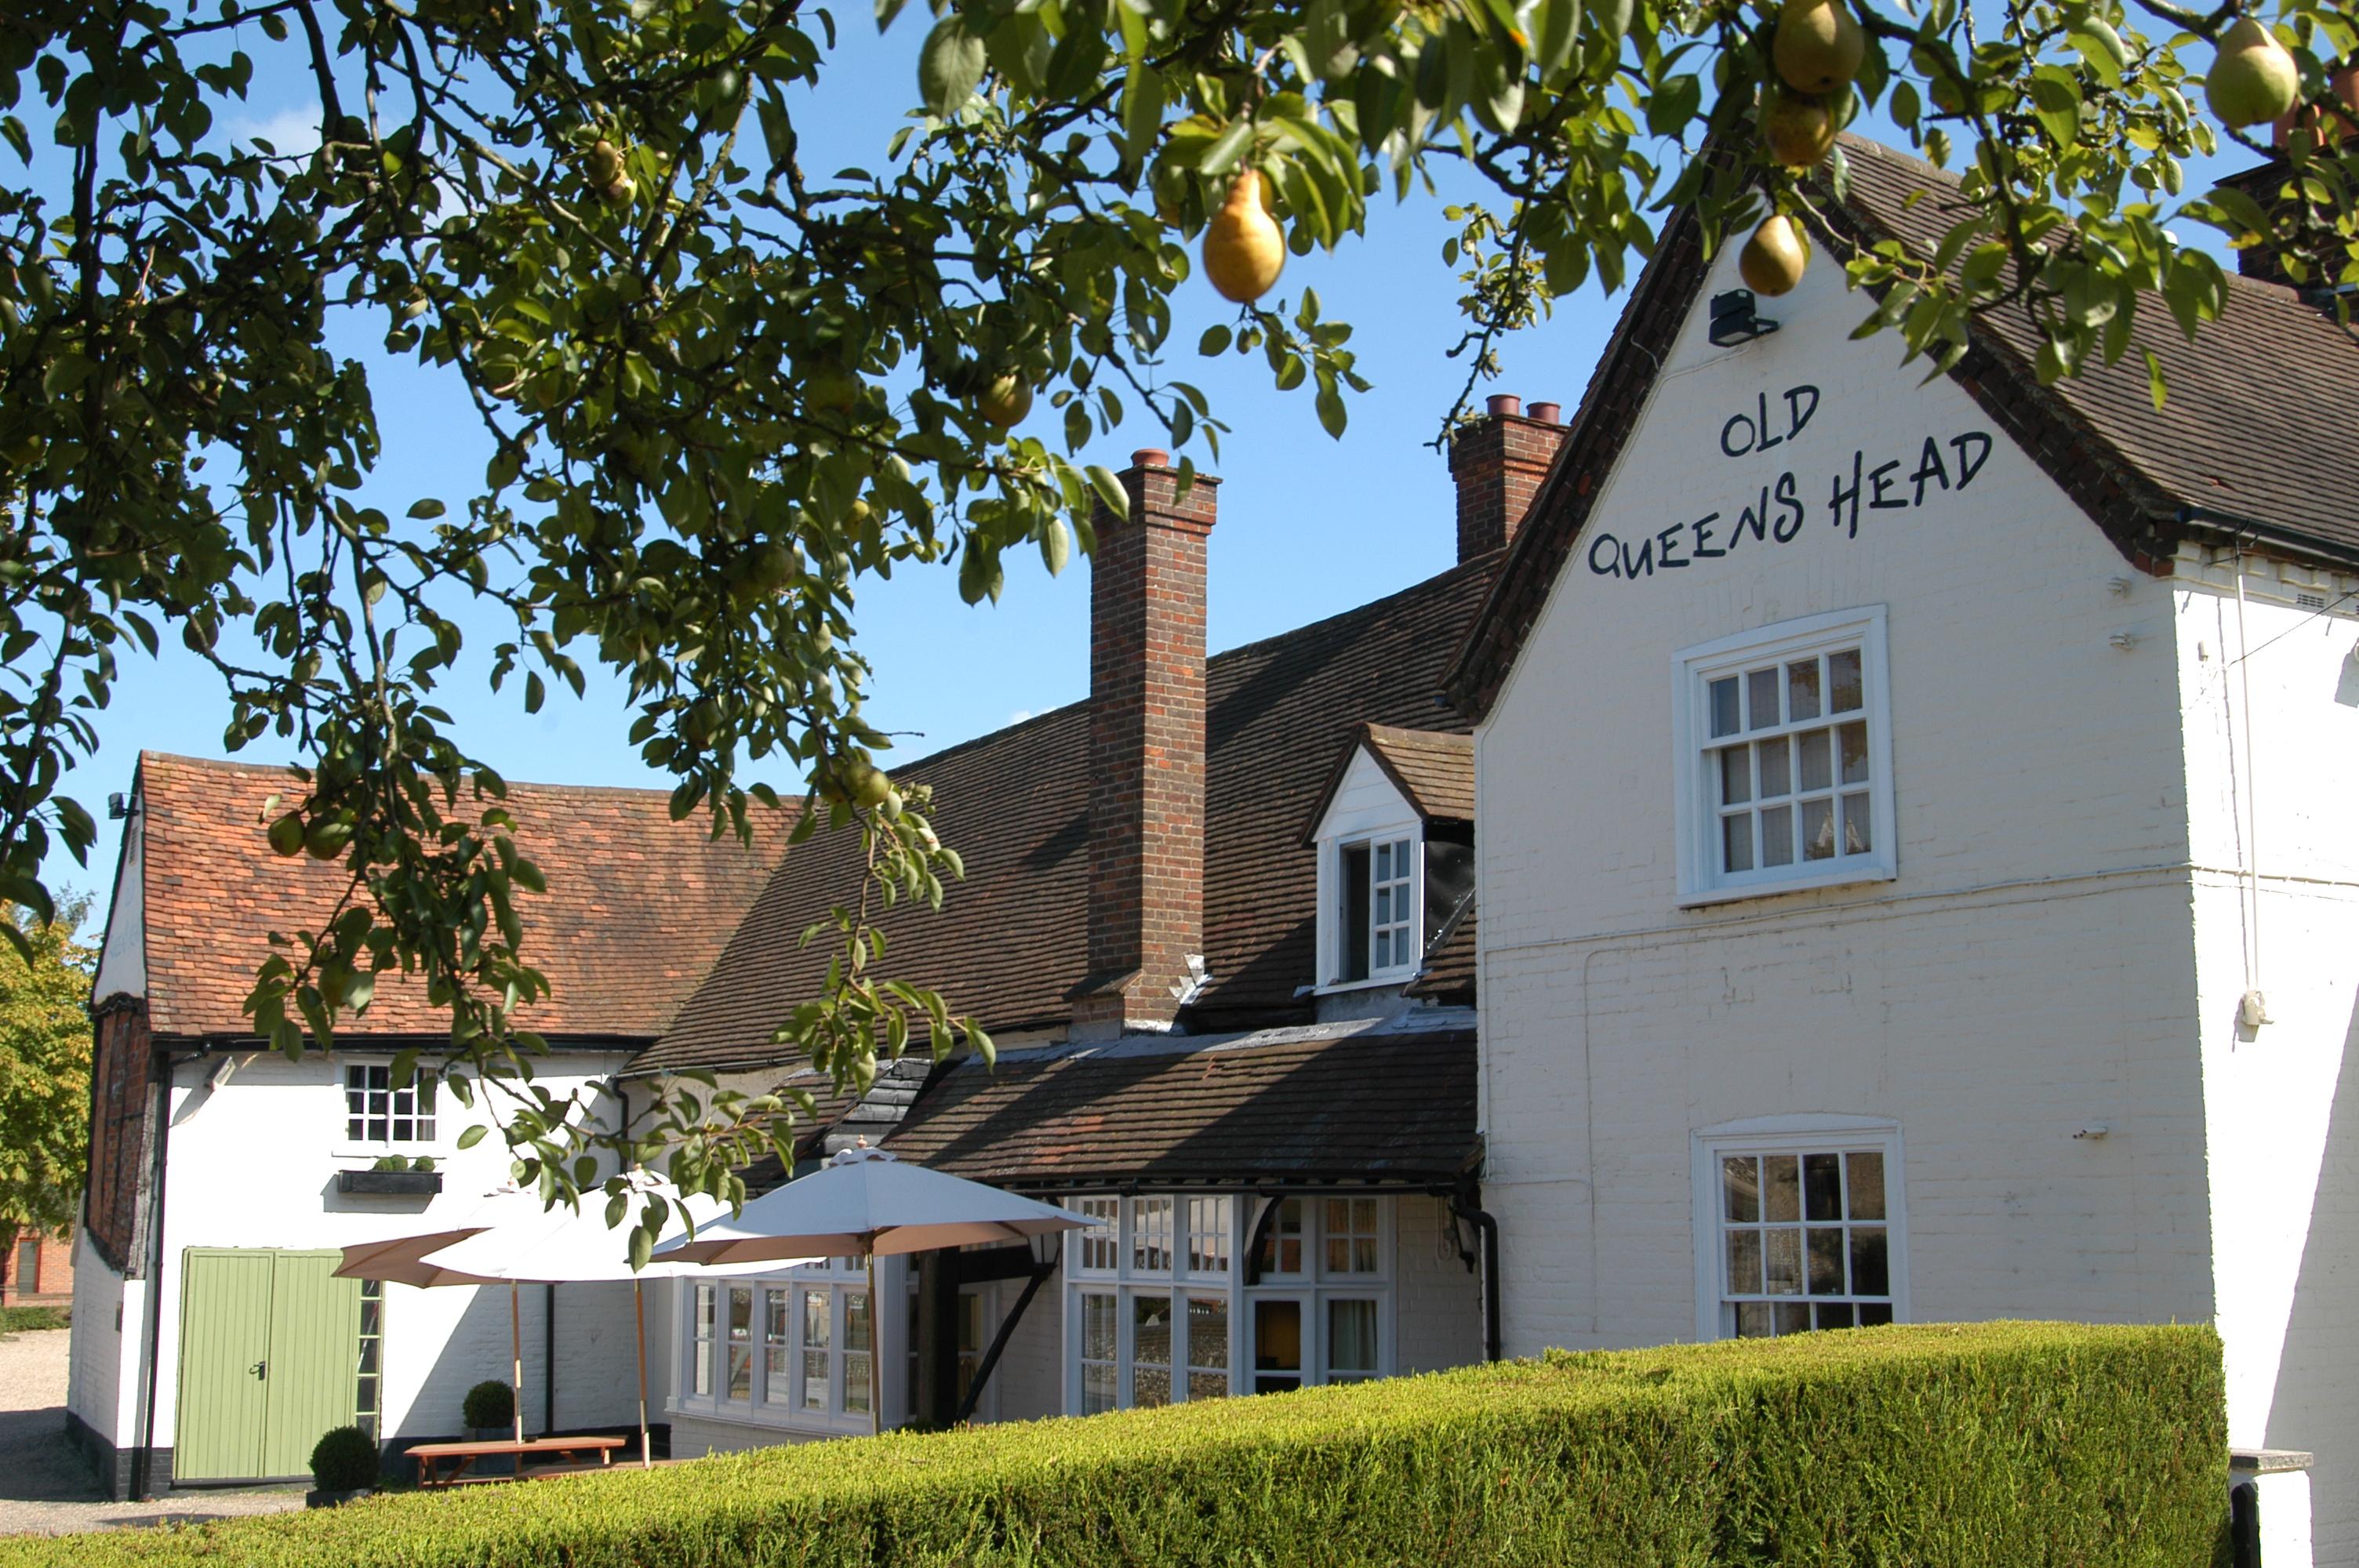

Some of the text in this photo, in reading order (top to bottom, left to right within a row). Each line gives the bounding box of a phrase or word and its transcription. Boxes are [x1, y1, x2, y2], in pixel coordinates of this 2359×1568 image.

[1721, 384, 1820, 458] OLD
[1588, 431, 1993, 580] QUEENS HEAD
